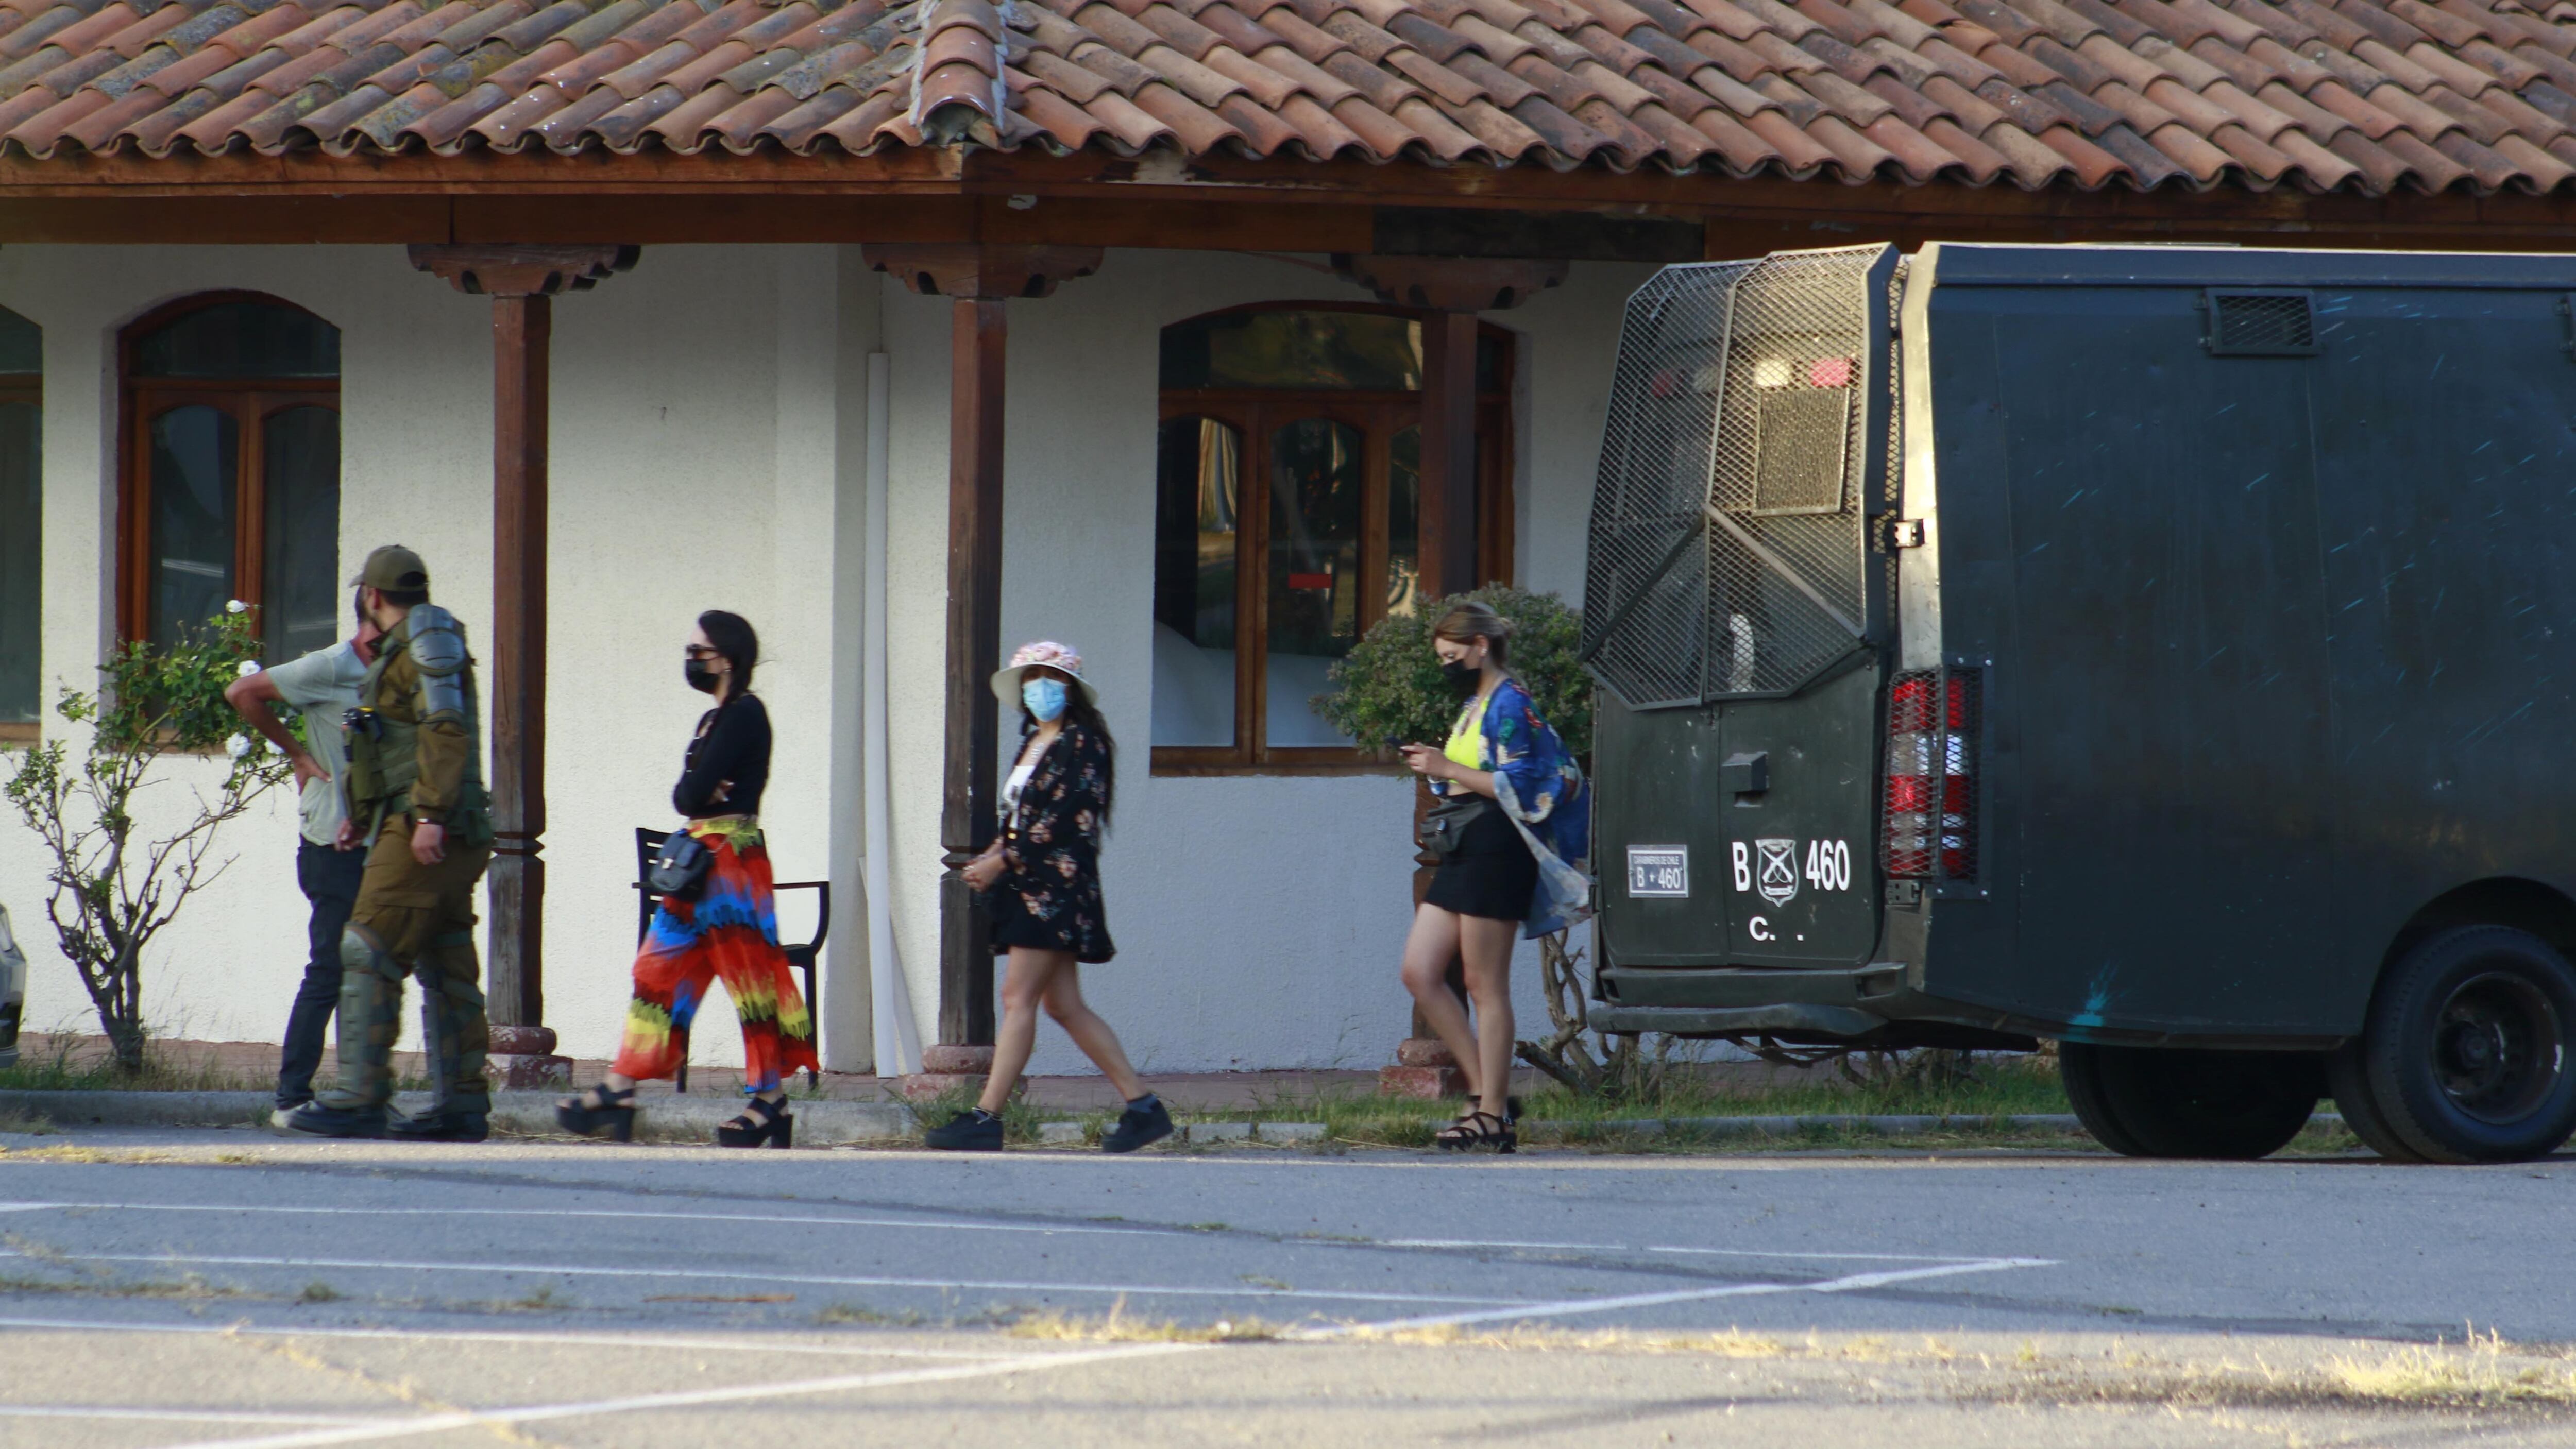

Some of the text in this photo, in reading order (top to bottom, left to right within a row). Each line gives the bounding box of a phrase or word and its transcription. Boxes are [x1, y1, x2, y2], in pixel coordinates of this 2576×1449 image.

[1637, 866, 1681, 889] B 460
[1732, 840, 1851, 891] B 460
